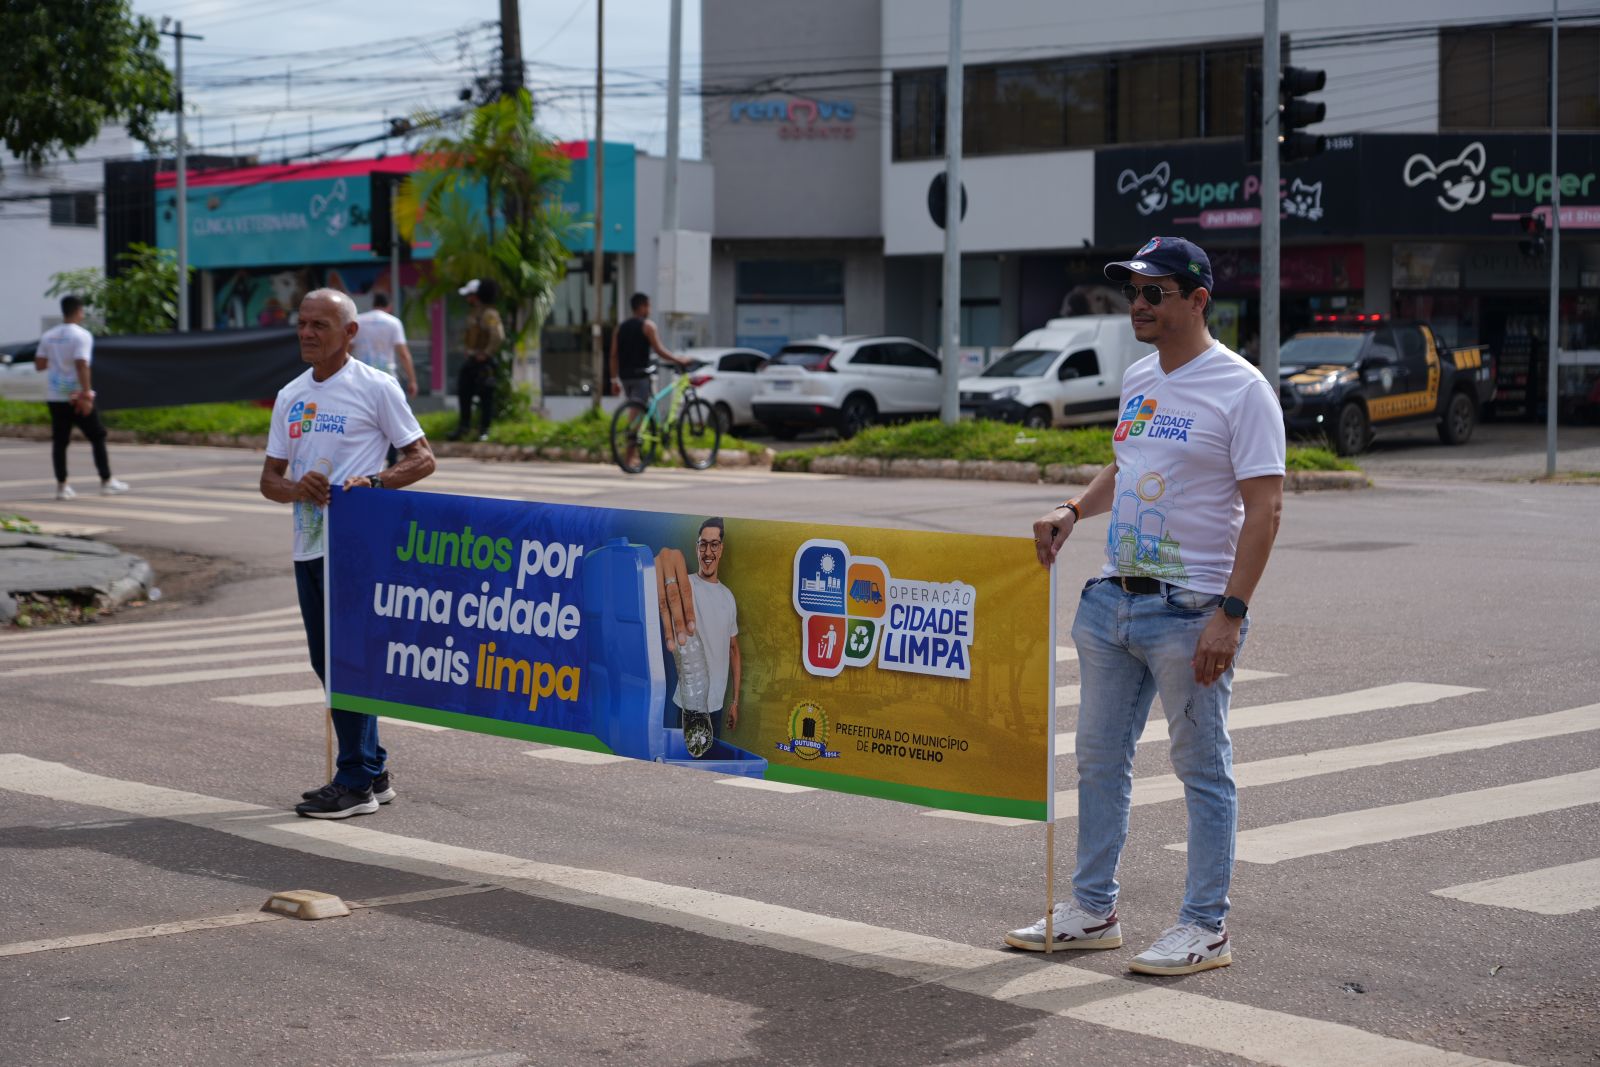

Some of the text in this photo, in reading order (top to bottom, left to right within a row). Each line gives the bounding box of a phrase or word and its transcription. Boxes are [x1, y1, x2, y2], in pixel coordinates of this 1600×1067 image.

[1171, 178, 1240, 207] Super
[1490, 167, 1595, 203] Super
[314, 422, 345, 434] LIMPA
[316, 413, 347, 425] CIDADE
[1153, 415, 1194, 430] CIDADE
[1147, 426, 1188, 442] LIMPA
[396, 521, 583, 589] Juntos por
[890, 586, 971, 606] OPERAÇÃO
[374, 581, 581, 640] uma cidade
[890, 604, 968, 636] CIDADE
[884, 633, 965, 670] LIMPA
[386, 636, 580, 711] mais limpa
[794, 739, 821, 750] OUTUBRO
[835, 723, 891, 741] PREFEITURA
[894, 731, 910, 744] DO
[856, 740, 943, 763] DE PORTO VELHO
